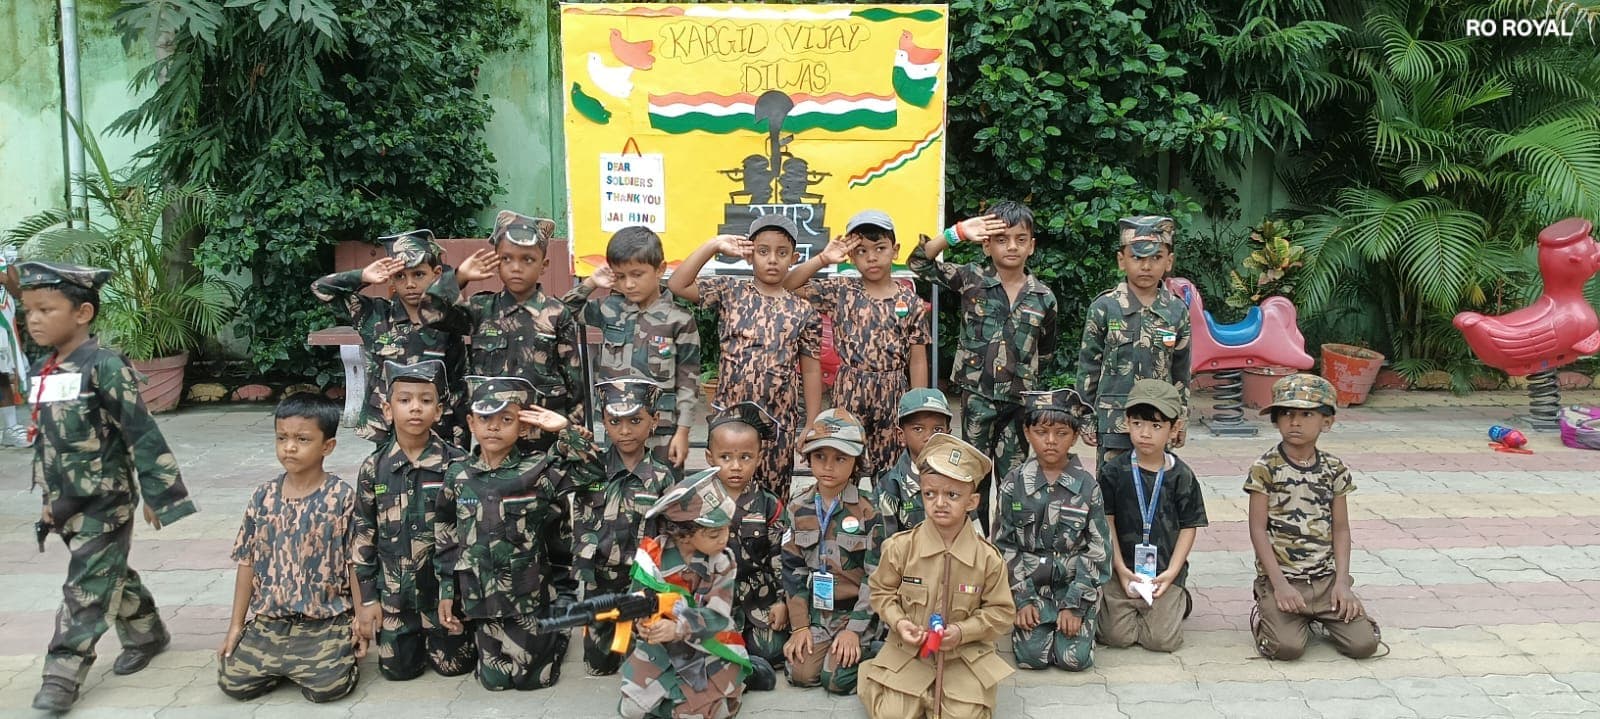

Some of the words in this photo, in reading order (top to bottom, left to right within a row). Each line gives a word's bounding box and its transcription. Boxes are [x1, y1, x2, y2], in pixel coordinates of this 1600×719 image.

[670, 25, 766, 57] KARGIL
[785, 25, 860, 51] VIJAY
[745, 63, 828, 93] DIWAS
[607, 161, 631, 172] DEAR
[606, 175, 654, 188] SOLDIERS
[606, 191, 640, 204] THANK
[642, 193, 661, 205] YOU
[607, 212, 623, 222] JAI
[628, 212, 656, 223] HIND
